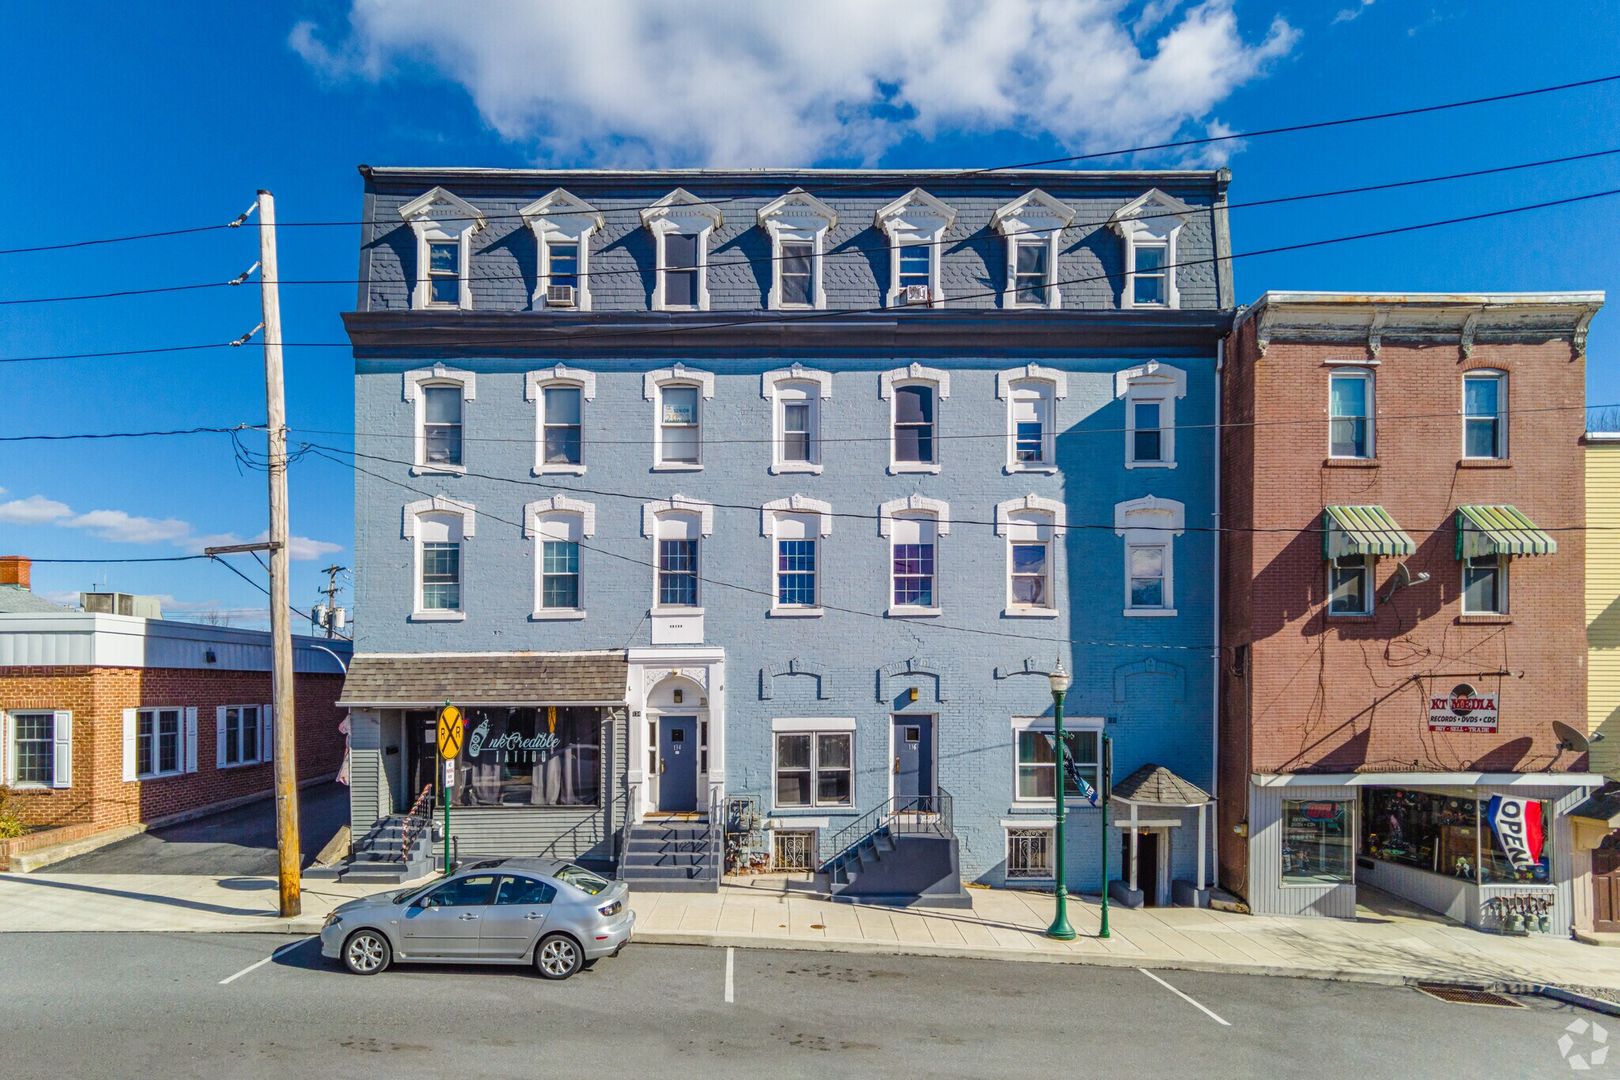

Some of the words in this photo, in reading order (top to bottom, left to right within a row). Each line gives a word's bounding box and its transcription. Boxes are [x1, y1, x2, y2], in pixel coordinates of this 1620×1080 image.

[1430, 698, 1448, 710] KT
[1450, 698, 1497, 711] MEDIA
[1430, 715, 1457, 723] RECORDS
[495, 750, 547, 763] TATTOO
[1499, 801, 1530, 864] OPEN
